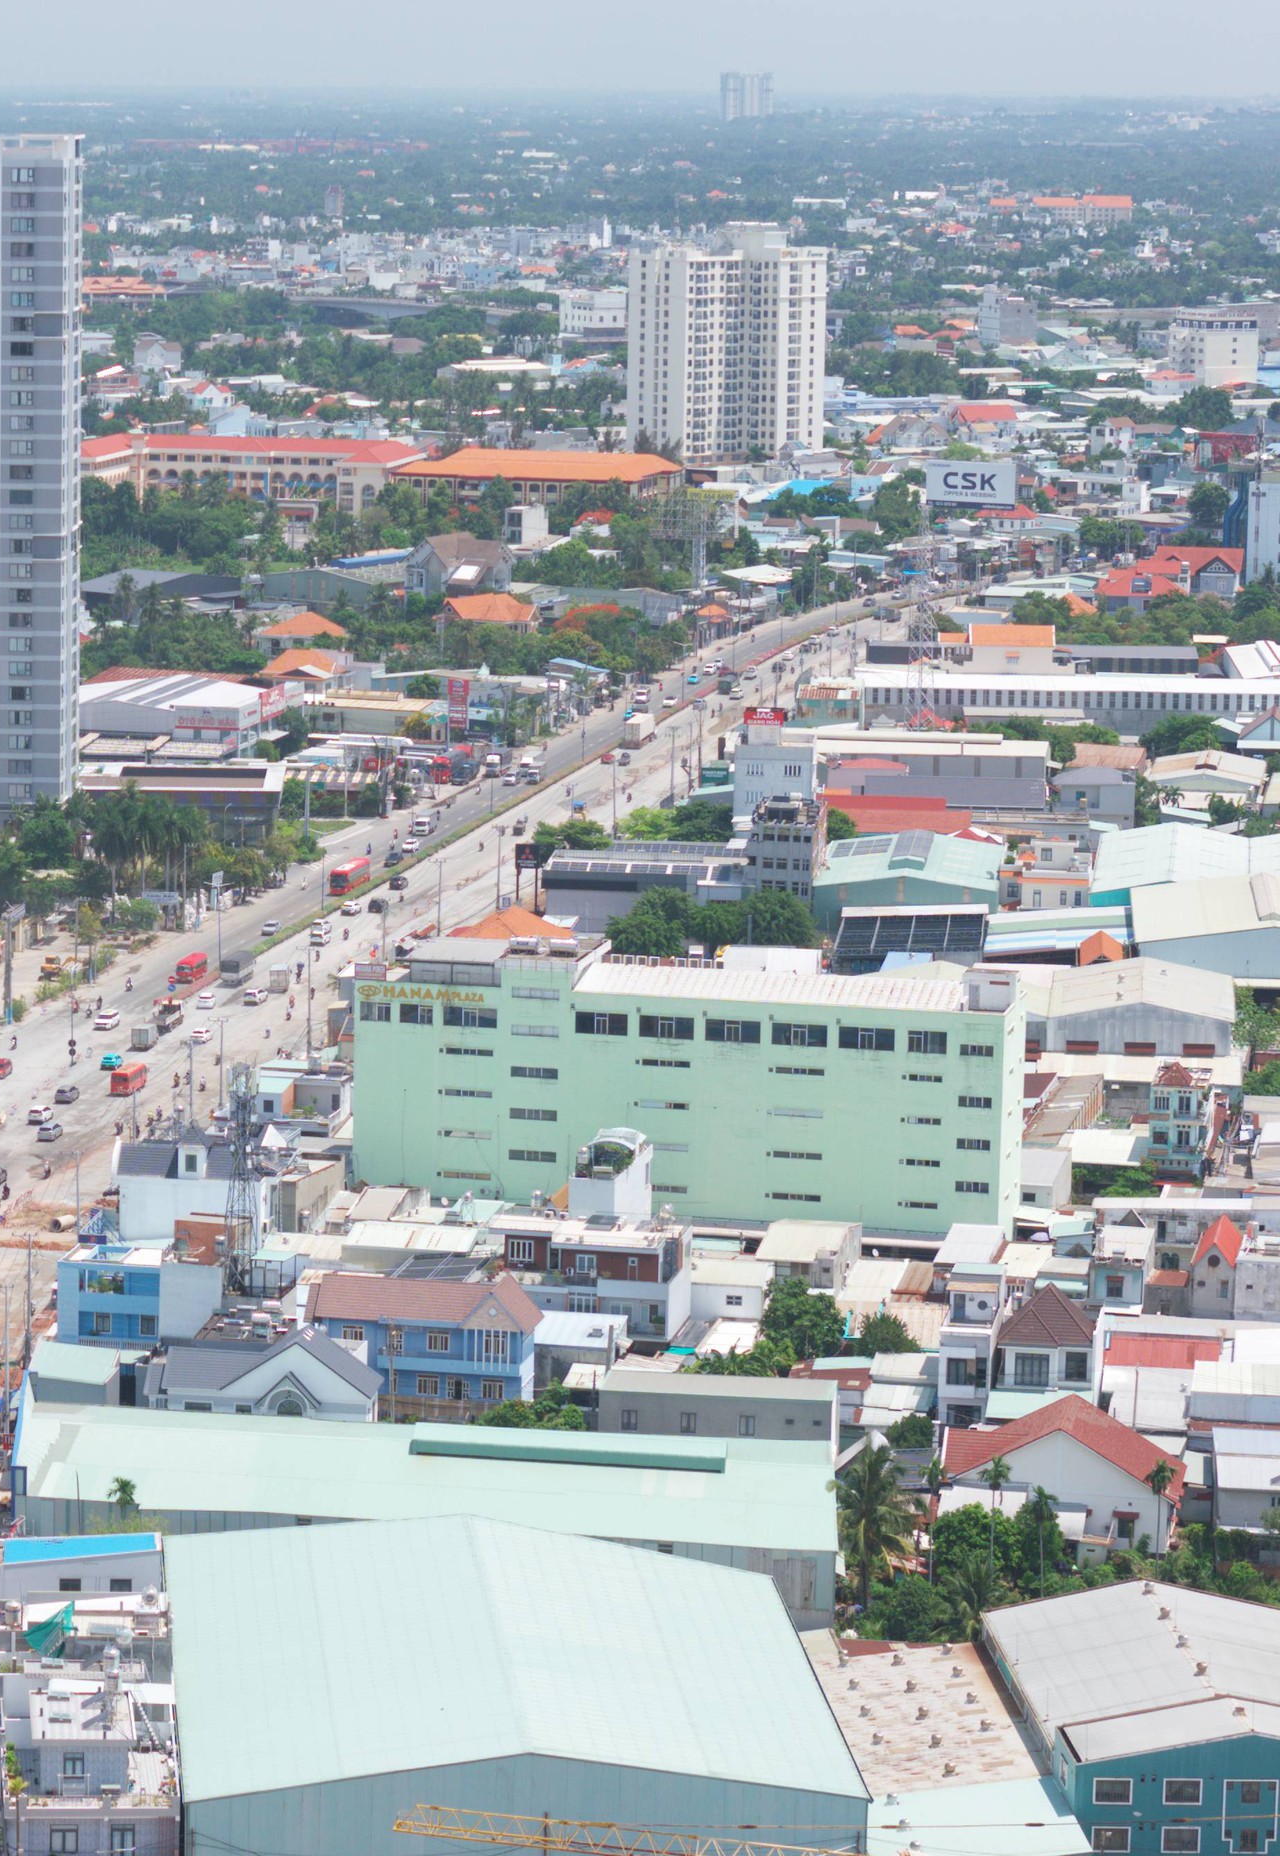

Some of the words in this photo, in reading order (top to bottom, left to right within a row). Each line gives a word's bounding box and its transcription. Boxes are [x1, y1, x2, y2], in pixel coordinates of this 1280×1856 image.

[943, 471, 997, 491] CSK
[752, 711, 775, 719] JAC
[383, 985, 451, 1002] HANAM
[451, 991, 484, 1003] PLAZA
